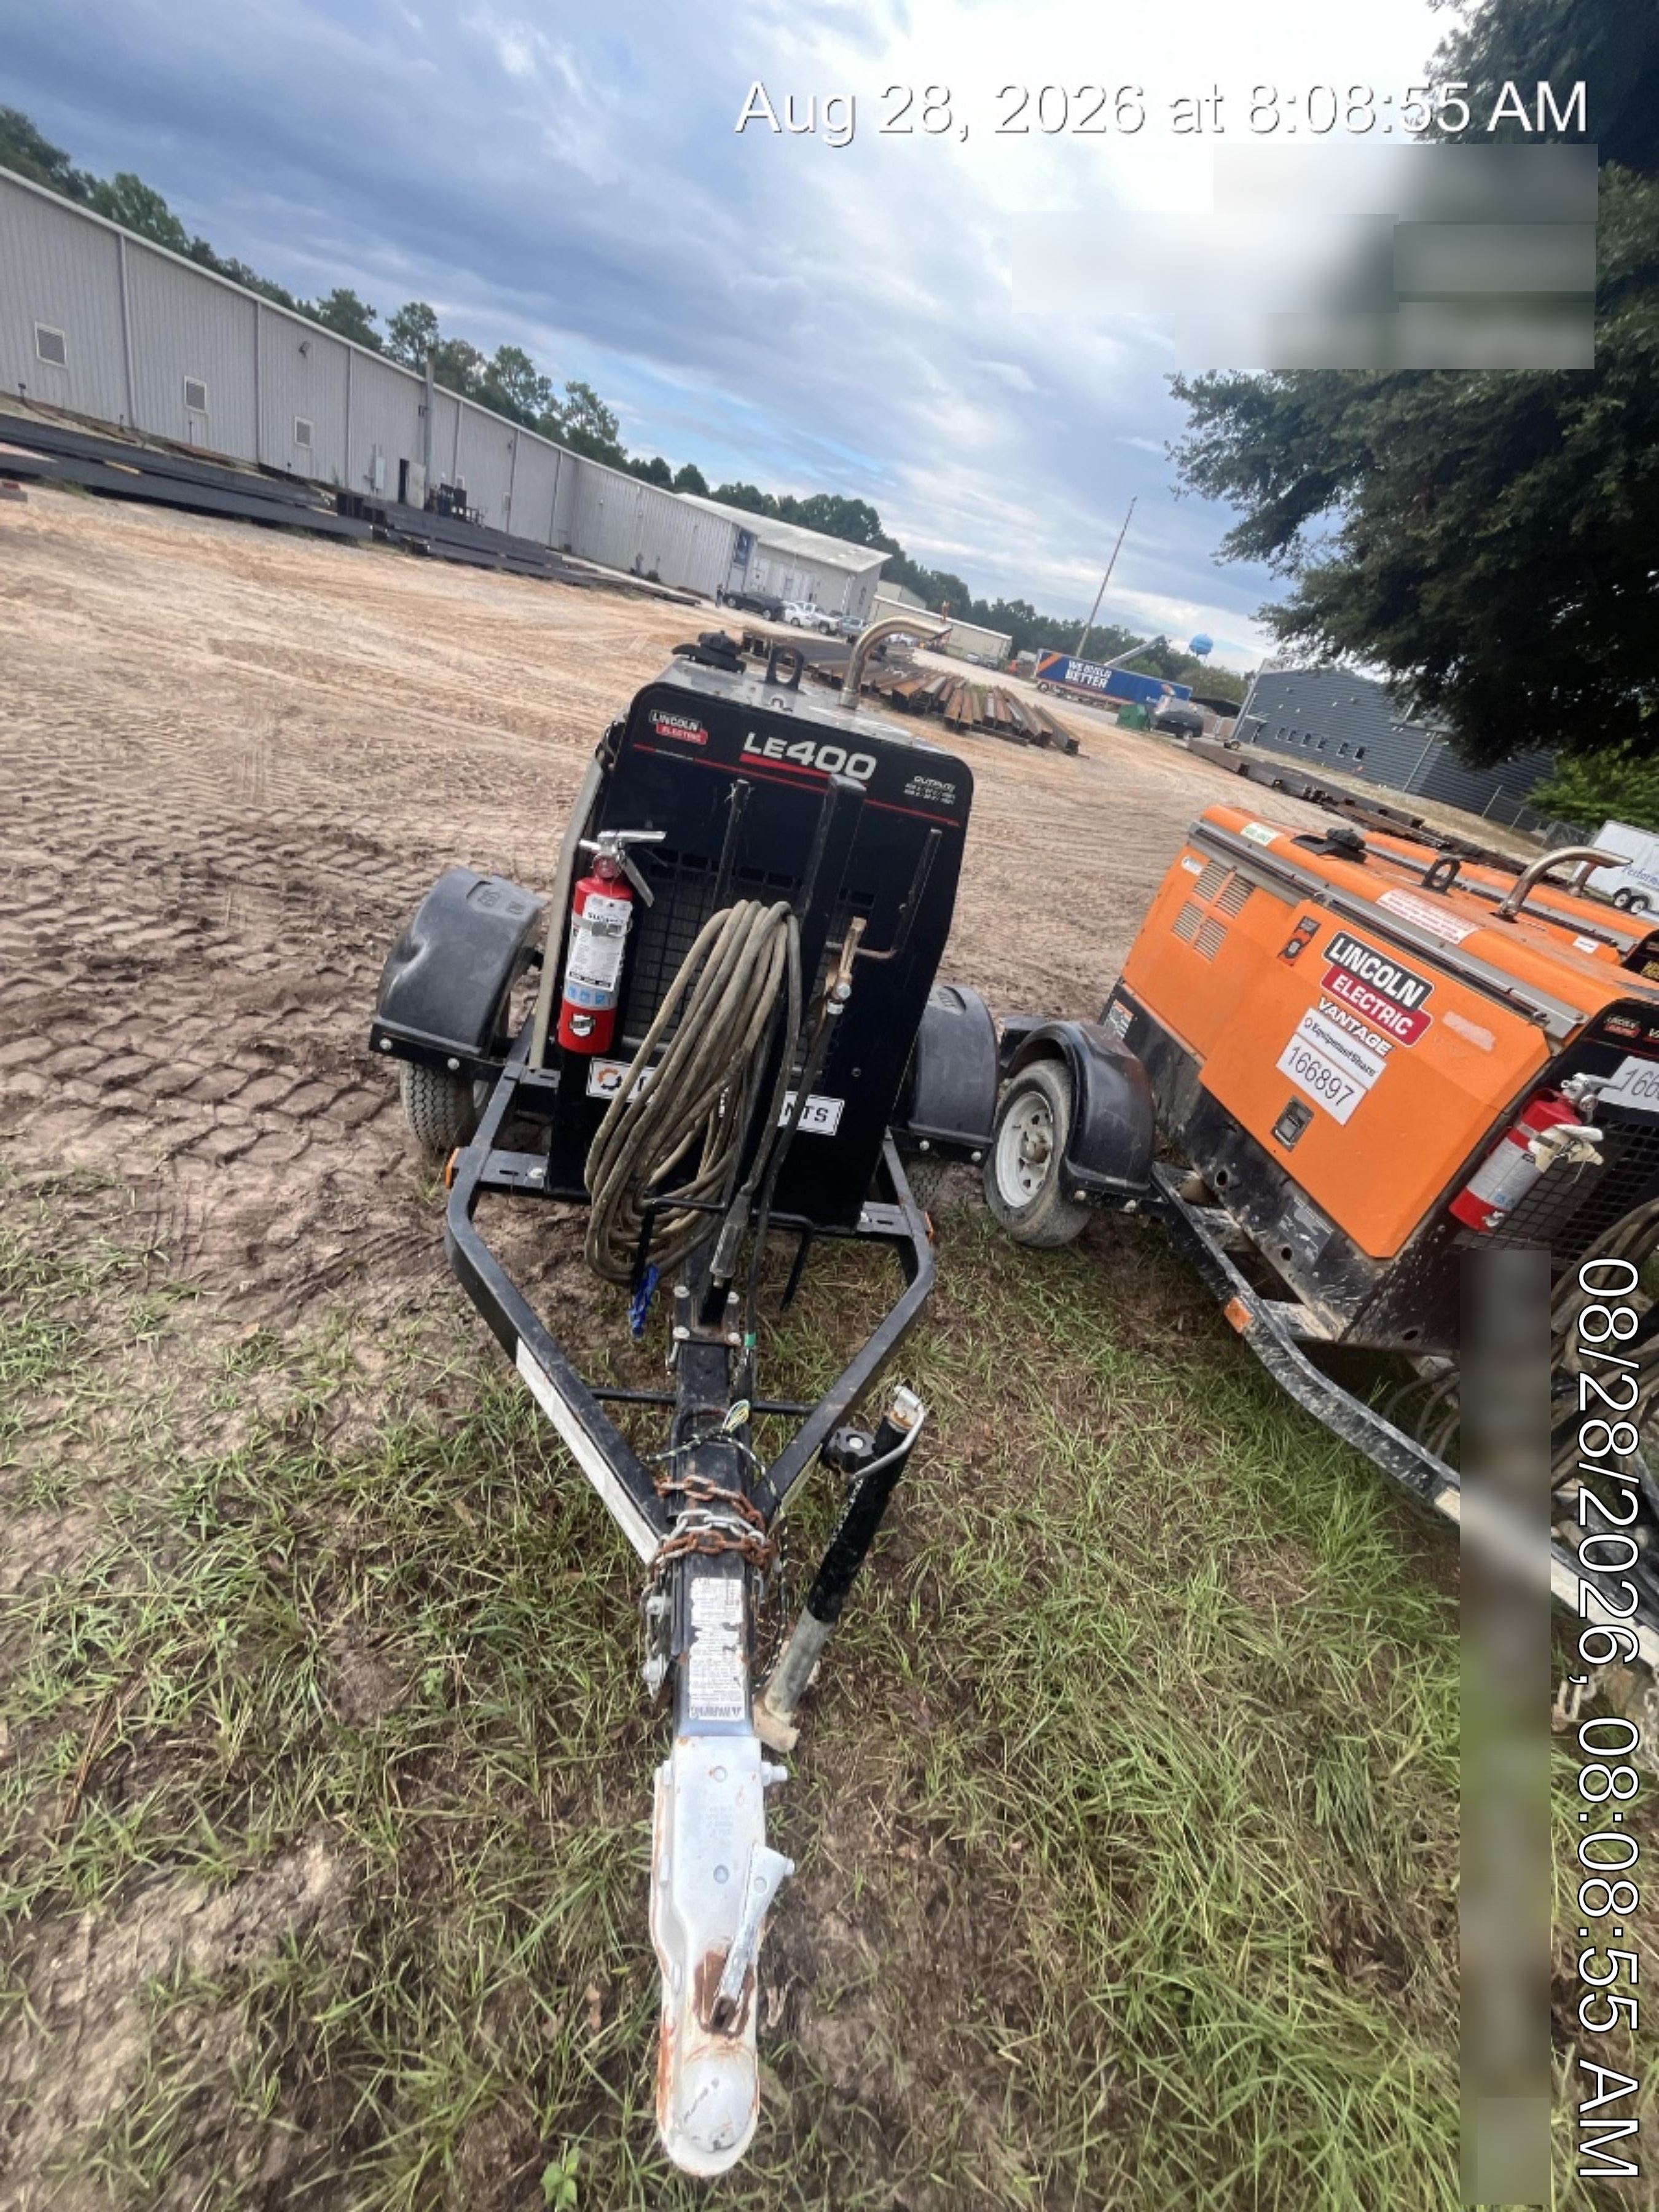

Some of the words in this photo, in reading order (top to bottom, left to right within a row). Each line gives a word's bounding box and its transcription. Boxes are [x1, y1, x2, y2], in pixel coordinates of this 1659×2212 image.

[652, 712, 699, 731] LINCOLN
[742, 731, 877, 780] LE400
[1329, 937, 1425, 1008] LINCOLN
[1318, 998, 1393, 1057] VANTAGE
[1332, 974, 1414, 1036] ELECTRIC
[1287, 1045, 1355, 1107] 166897
[1311, 1022, 1377, 1078] EquipmentShare
[1620, 1069, 1659, 1100] 166
